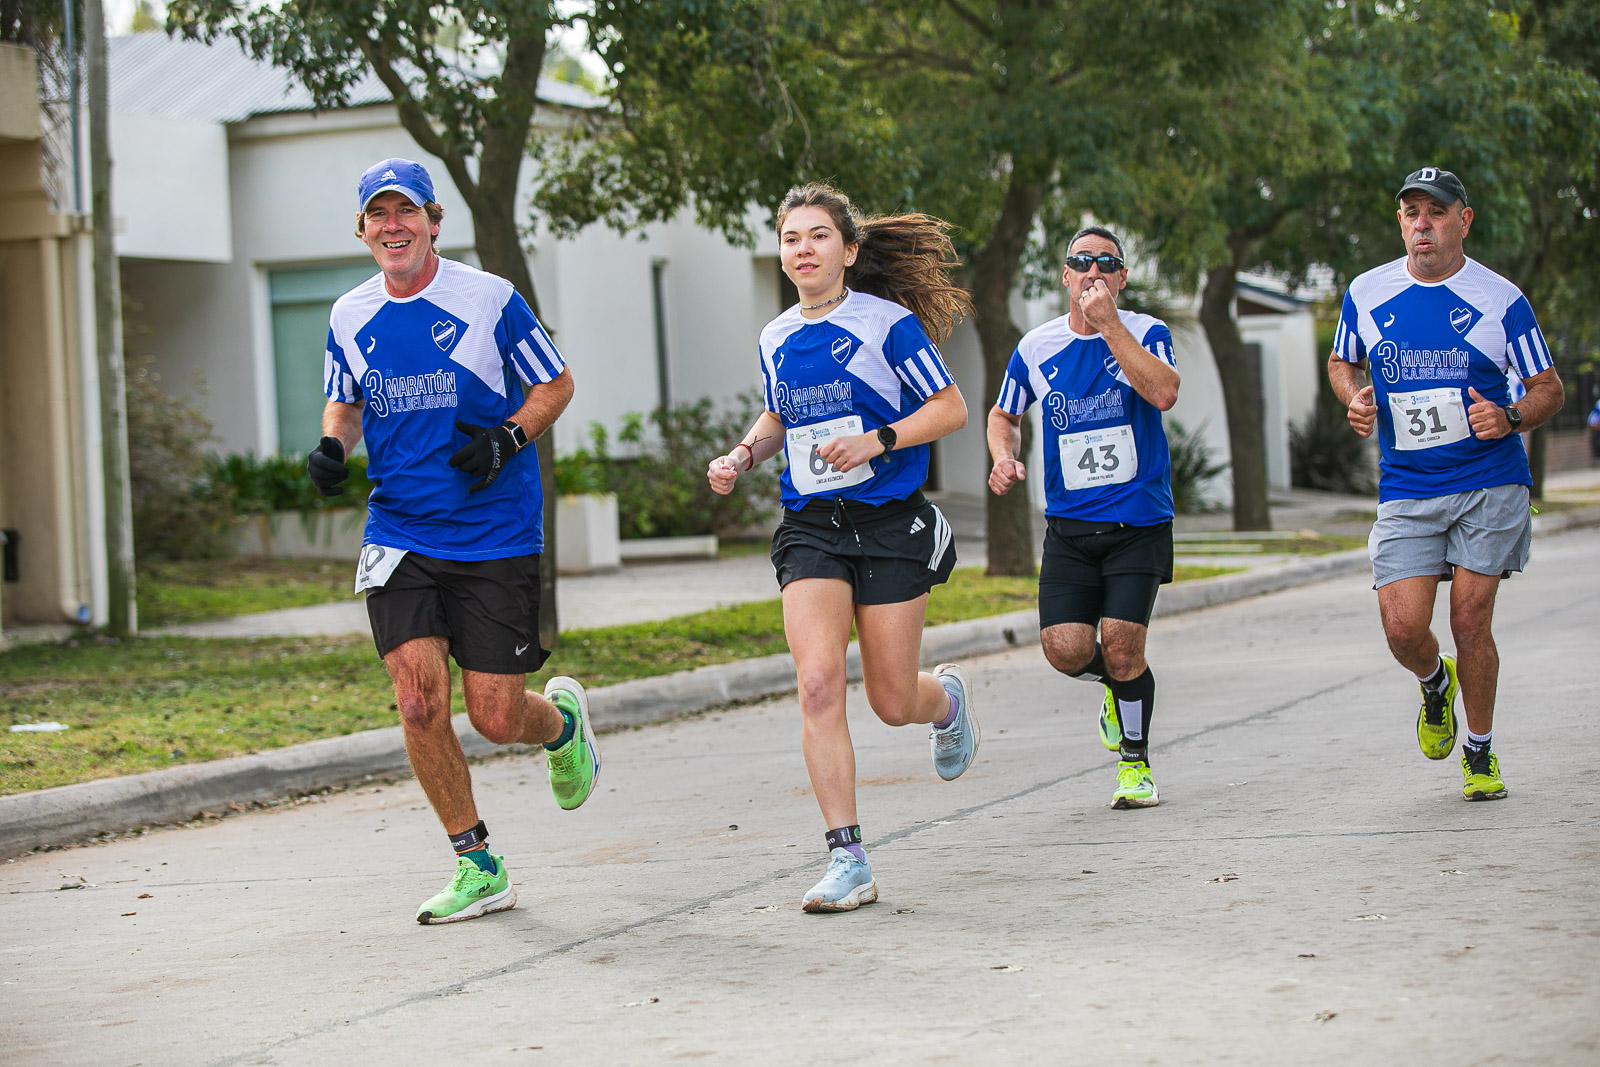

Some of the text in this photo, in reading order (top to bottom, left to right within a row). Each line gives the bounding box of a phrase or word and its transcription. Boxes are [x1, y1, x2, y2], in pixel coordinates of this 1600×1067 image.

[1418, 167, 1437, 181] D
[1377, 340, 1399, 384] 3
[1400, 347, 1469, 368] MARATÓN
[365, 369, 389, 418] 3
[385, 368, 457, 399] MARATÓN
[790, 379, 852, 408] MARATÓN
[776, 381, 798, 424] 3
[1048, 391, 1069, 431] 3
[1405, 406, 1448, 437] 31
[809, 443, 843, 476] 6
[1077, 444, 1120, 474] 43
[478, 882, 491, 896] FILA
